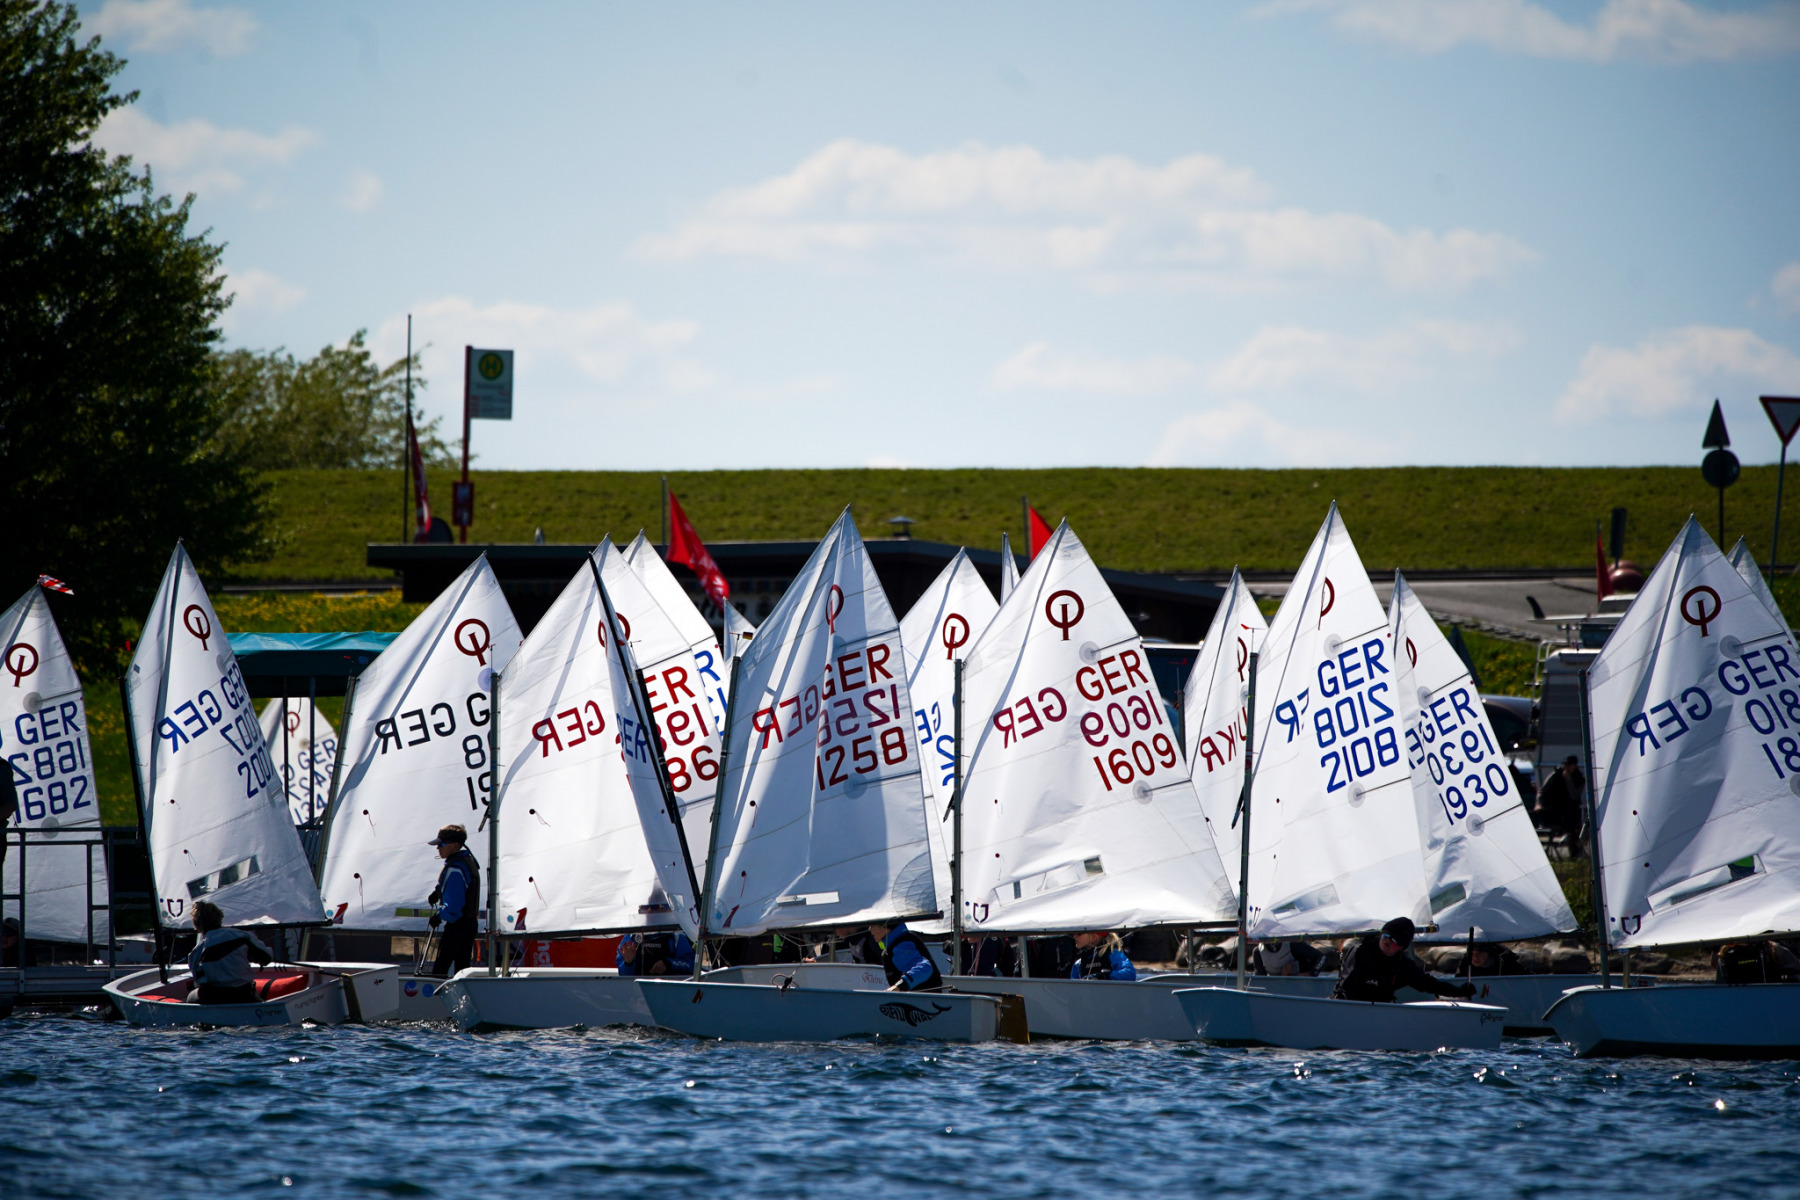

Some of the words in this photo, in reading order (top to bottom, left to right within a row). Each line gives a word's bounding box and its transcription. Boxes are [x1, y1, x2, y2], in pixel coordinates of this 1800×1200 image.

[220, 662, 248, 710] GER
[644, 666, 696, 714] ER
[822, 643, 894, 700] GER
[1075, 649, 1149, 702] GER
[1317, 638, 1390, 698] GER
[1718, 644, 1800, 696] GER
[15, 701, 81, 745] GER
[1419, 688, 1478, 743] GER
[816, 726, 908, 791] 1258
[1093, 732, 1177, 791] 1609
[1320, 726, 1400, 794] 2108
[1439, 763, 1509, 826] 1930
